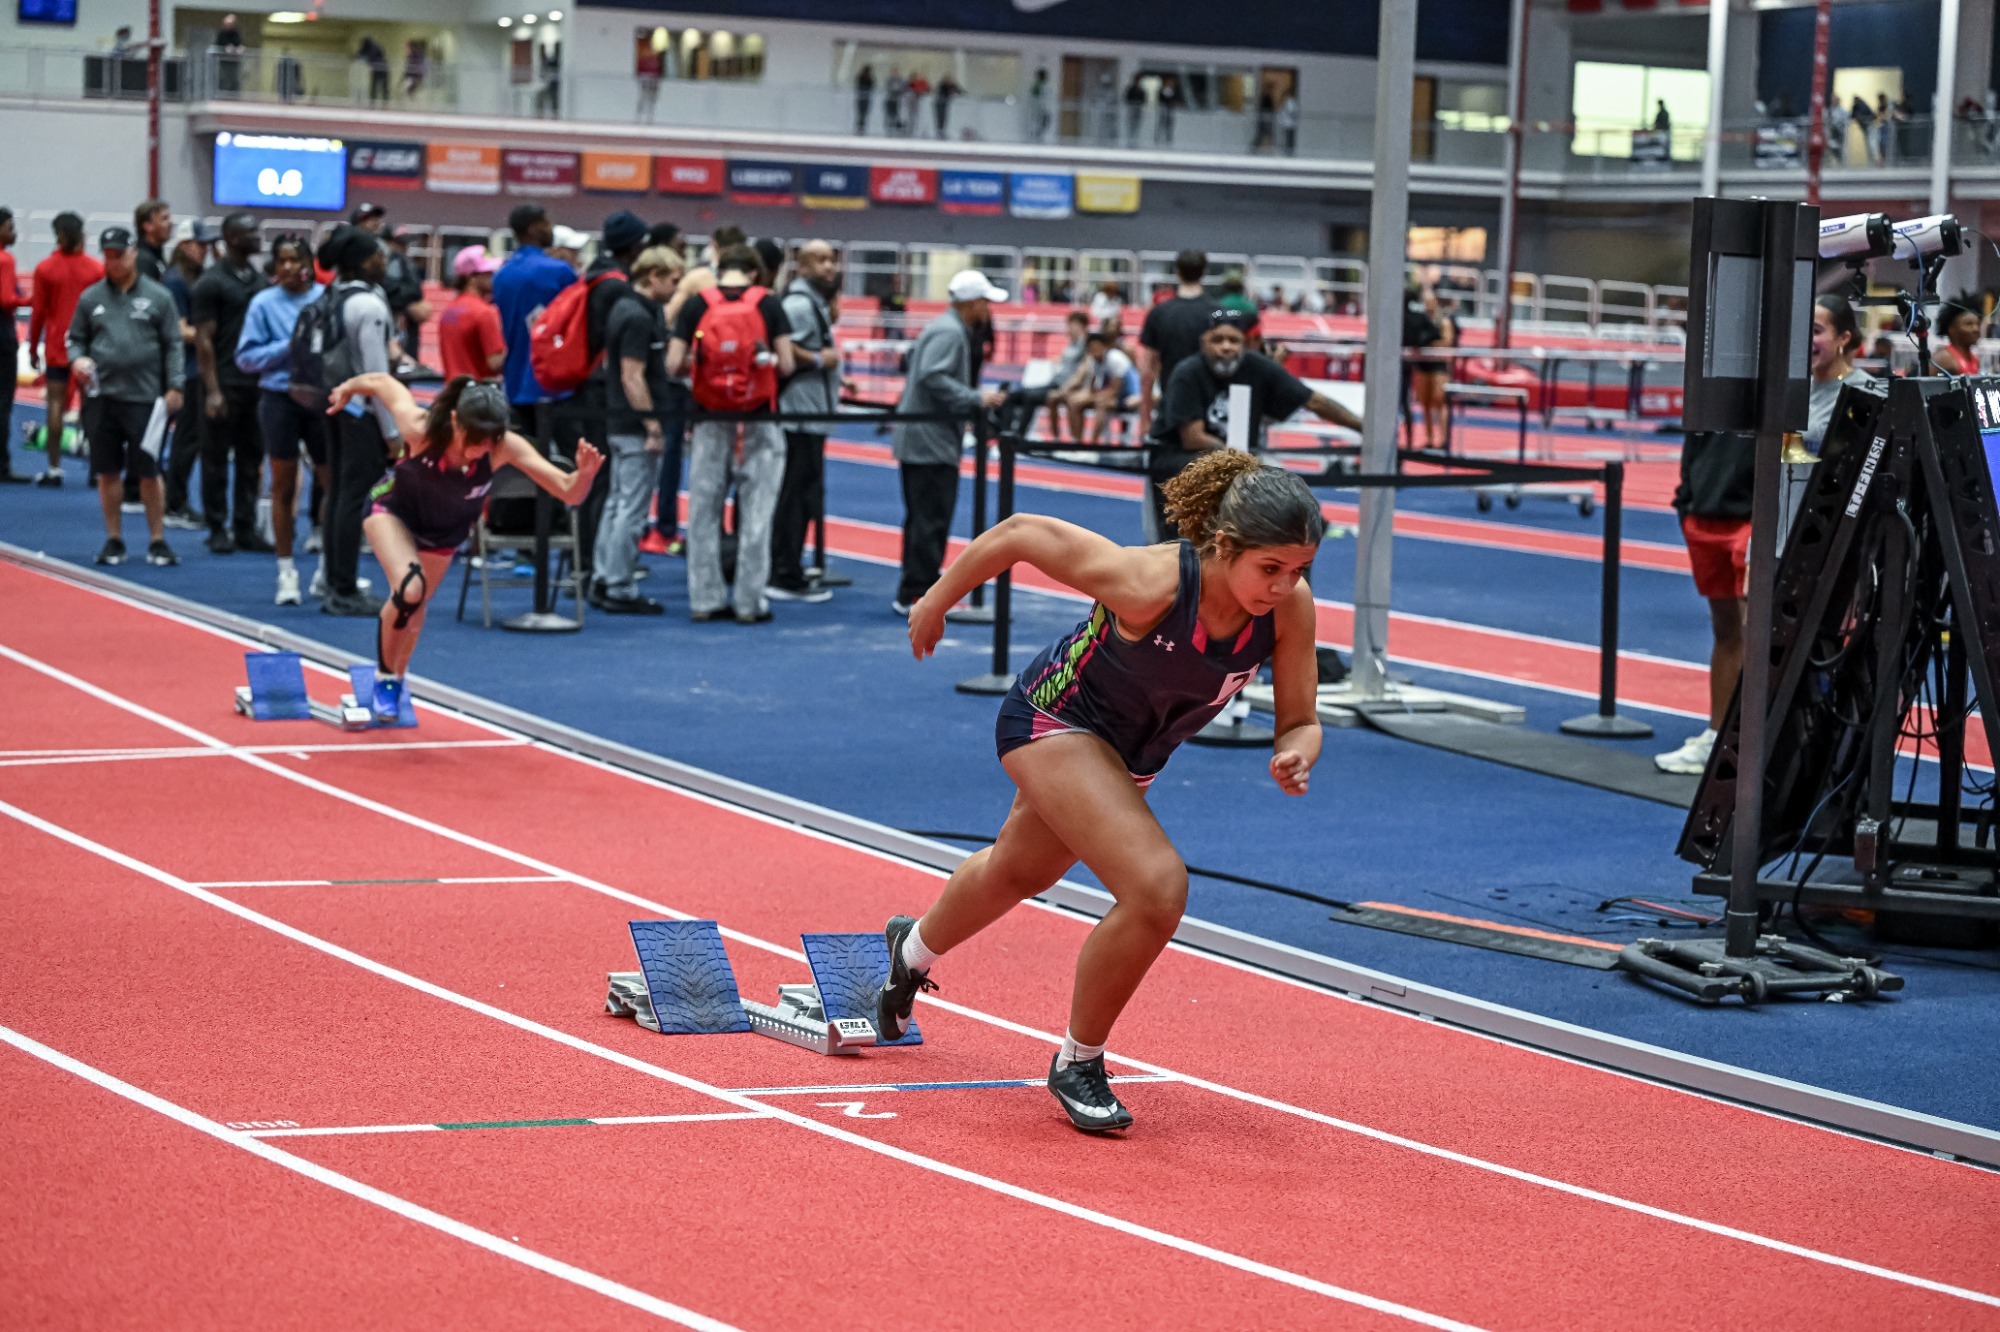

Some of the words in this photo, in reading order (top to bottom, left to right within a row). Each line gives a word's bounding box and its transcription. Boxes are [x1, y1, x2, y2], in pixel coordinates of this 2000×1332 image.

[1847, 438, 1885, 516] LTJ-FINISH
[657, 941, 708, 957] GILL
[829, 952, 879, 969] GILL
[840, 1021, 868, 1029] GILL
